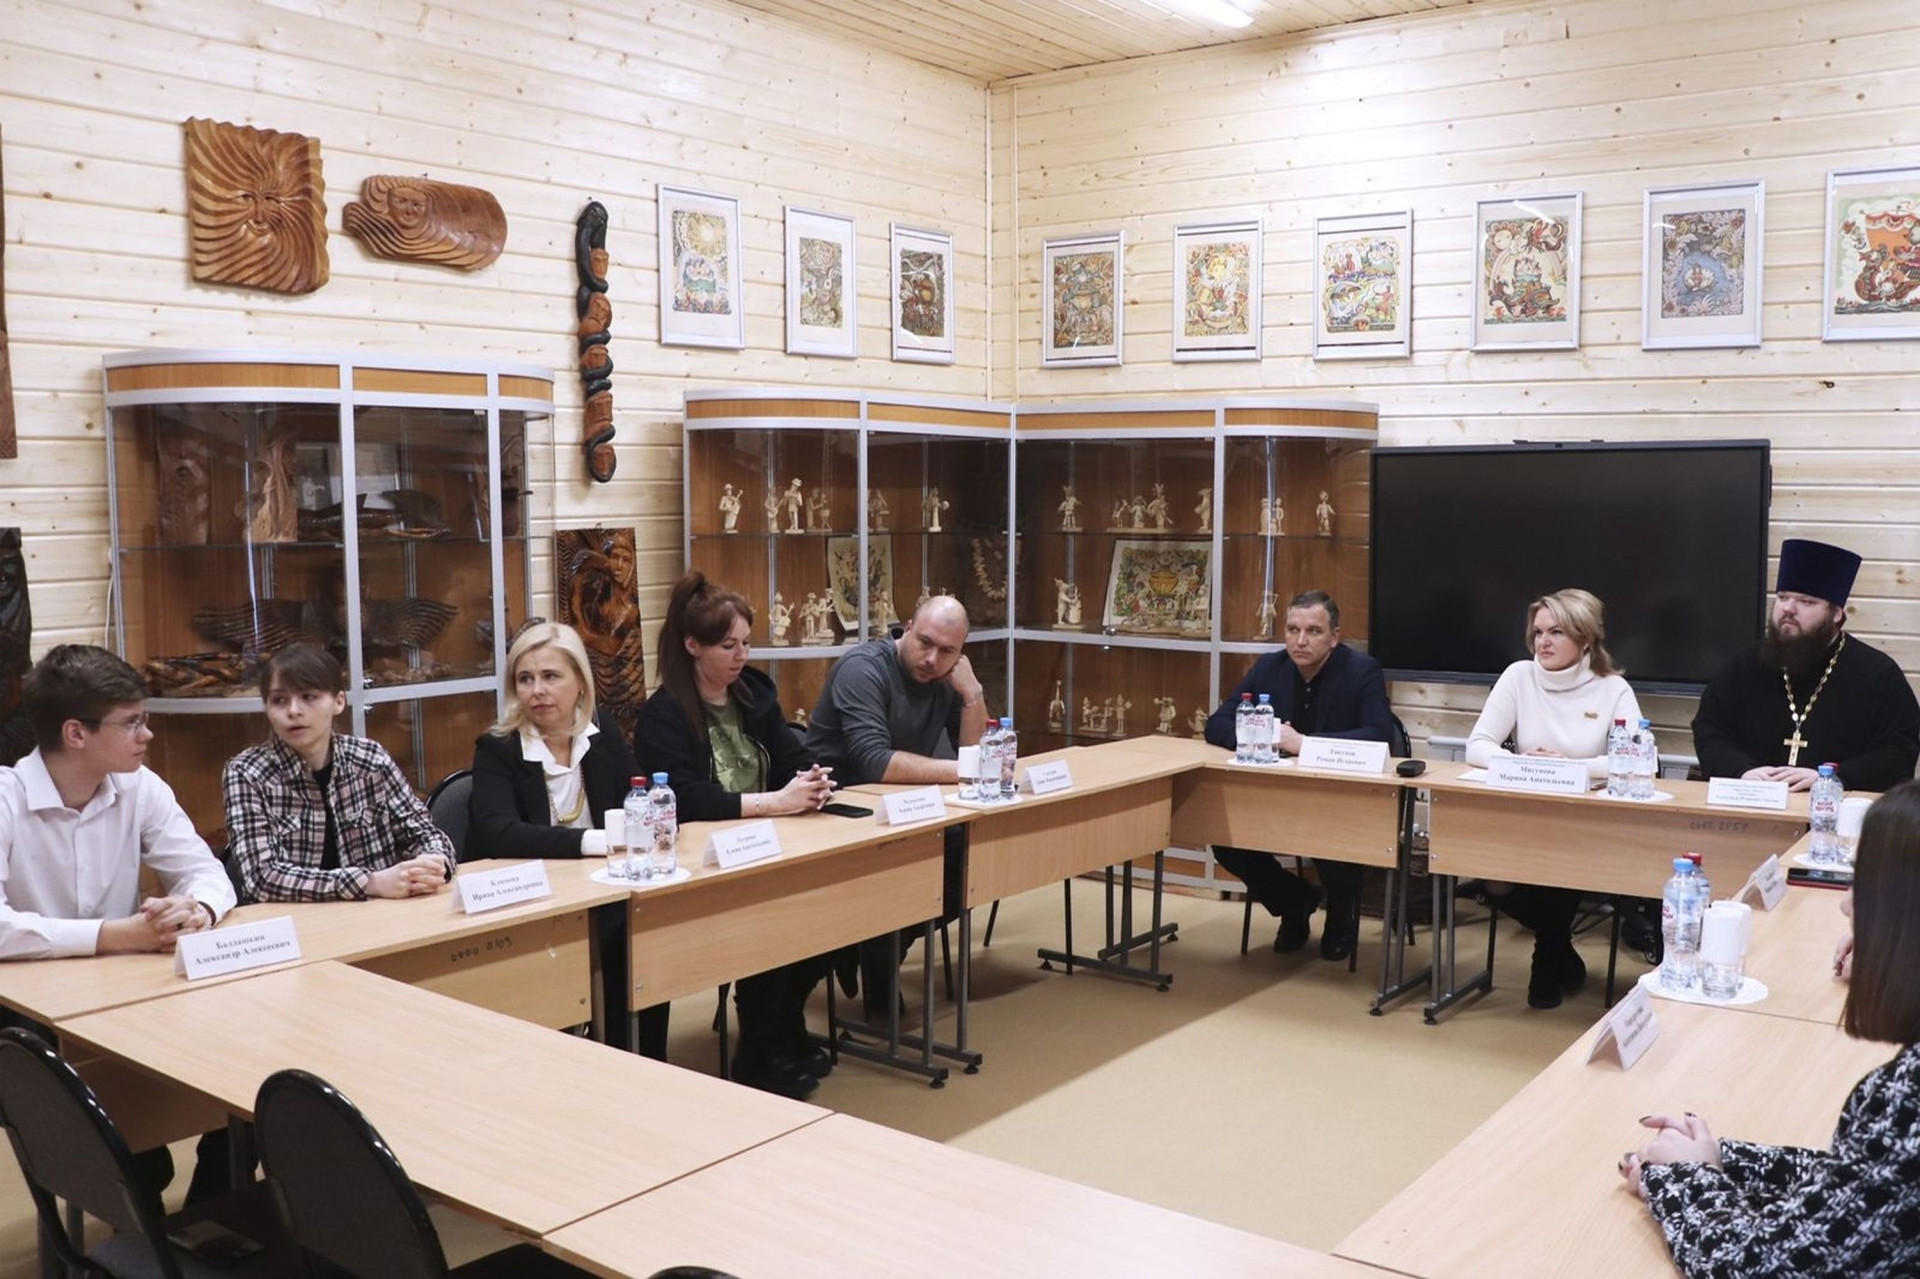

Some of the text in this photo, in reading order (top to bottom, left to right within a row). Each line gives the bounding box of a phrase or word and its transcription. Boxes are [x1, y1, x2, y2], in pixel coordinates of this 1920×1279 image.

[1499, 773, 1575, 786] Марина Анатольевна
[195, 940, 291, 966] Александр Алексеевич
